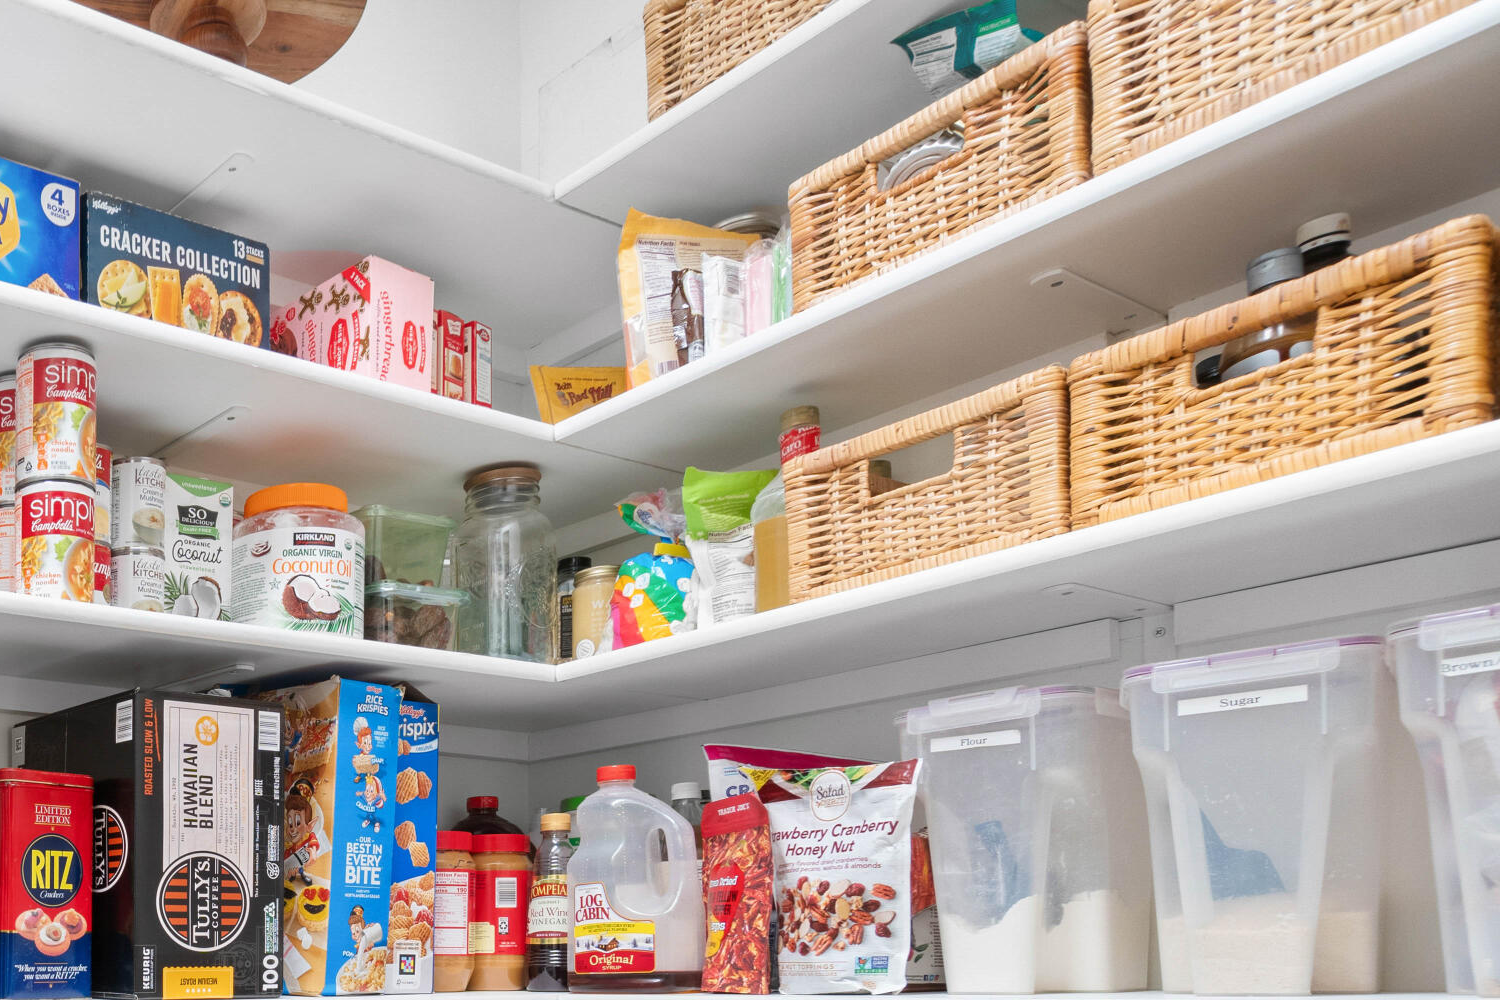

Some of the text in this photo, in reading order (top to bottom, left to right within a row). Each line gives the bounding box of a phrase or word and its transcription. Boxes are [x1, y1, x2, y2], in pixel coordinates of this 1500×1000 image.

[50, 189, 65, 207] 4
[46, 203, 70, 217] BOXES
[92, 197, 122, 216] Kellogg's
[233, 239, 246, 259] 13
[246, 246, 264, 259] STACKS
[100, 225, 261, 289] CRACKER COLLECTION
[46, 385, 87, 401] Campbell's
[568, 390, 589, 407] Red
[51, 439, 77, 447] chicken
[188, 507, 208, 519] SO
[31, 518, 74, 533] Campbell's
[181, 516, 214, 526] DELICIOUS
[295, 533, 335, 542] KIRKLAND
[708, 529, 737, 538] Nutrition
[184, 539, 211, 548] ORGANIC
[172, 539, 223, 564] Coconut
[282, 548, 343, 559] ORGANIC VIRGIN
[272, 558, 352, 577] Coconut Oil
[140, 579, 158, 587] Cream
[1440, 659, 1492, 673] Brown
[366, 686, 383, 694] Kellogg's
[365, 694, 384, 706] RICE
[1218, 694, 1261, 709] Sugar
[144, 698, 154, 718] LOW
[357, 703, 389, 716] KRISPIES
[144, 729, 154, 754] SLOW
[959, 736, 988, 747] Flour
[144, 756, 153, 796] ROASTED
[182, 743, 198, 829] HAWAIIAN
[816, 785, 845, 801] Salad
[199, 774, 214, 829] BLEND
[35, 804, 72, 816] LIMITED
[717, 803, 750, 816] TRADER JOE'S
[35, 814, 71, 825] EDITION
[831, 820, 899, 837] Cranberry
[93, 811, 106, 888] TULLY'S
[346, 843, 382, 854] BEST IN
[785, 841, 855, 858] Honey Nut
[345, 854, 382, 867] EVERY
[850, 862, 882, 870] almonds
[31, 849, 74, 890] RITZ
[344, 867, 381, 885] BITE
[39, 890, 65, 899] Crackers
[580, 893, 603, 909] LOG
[192, 860, 211, 944] TULLY'S
[211, 876, 219, 928] COFFEE
[530, 908, 544, 917] Red
[575, 907, 610, 923] CABIN
[530, 918, 568, 926] VINEGAR
[589, 955, 634, 966] Original
[35, 965, 46, 973] you
[142, 947, 150, 990] KEURIG
[262, 954, 279, 991] 100
[23, 973, 34, 981] you
[197, 977, 218, 985] MEDIUM
